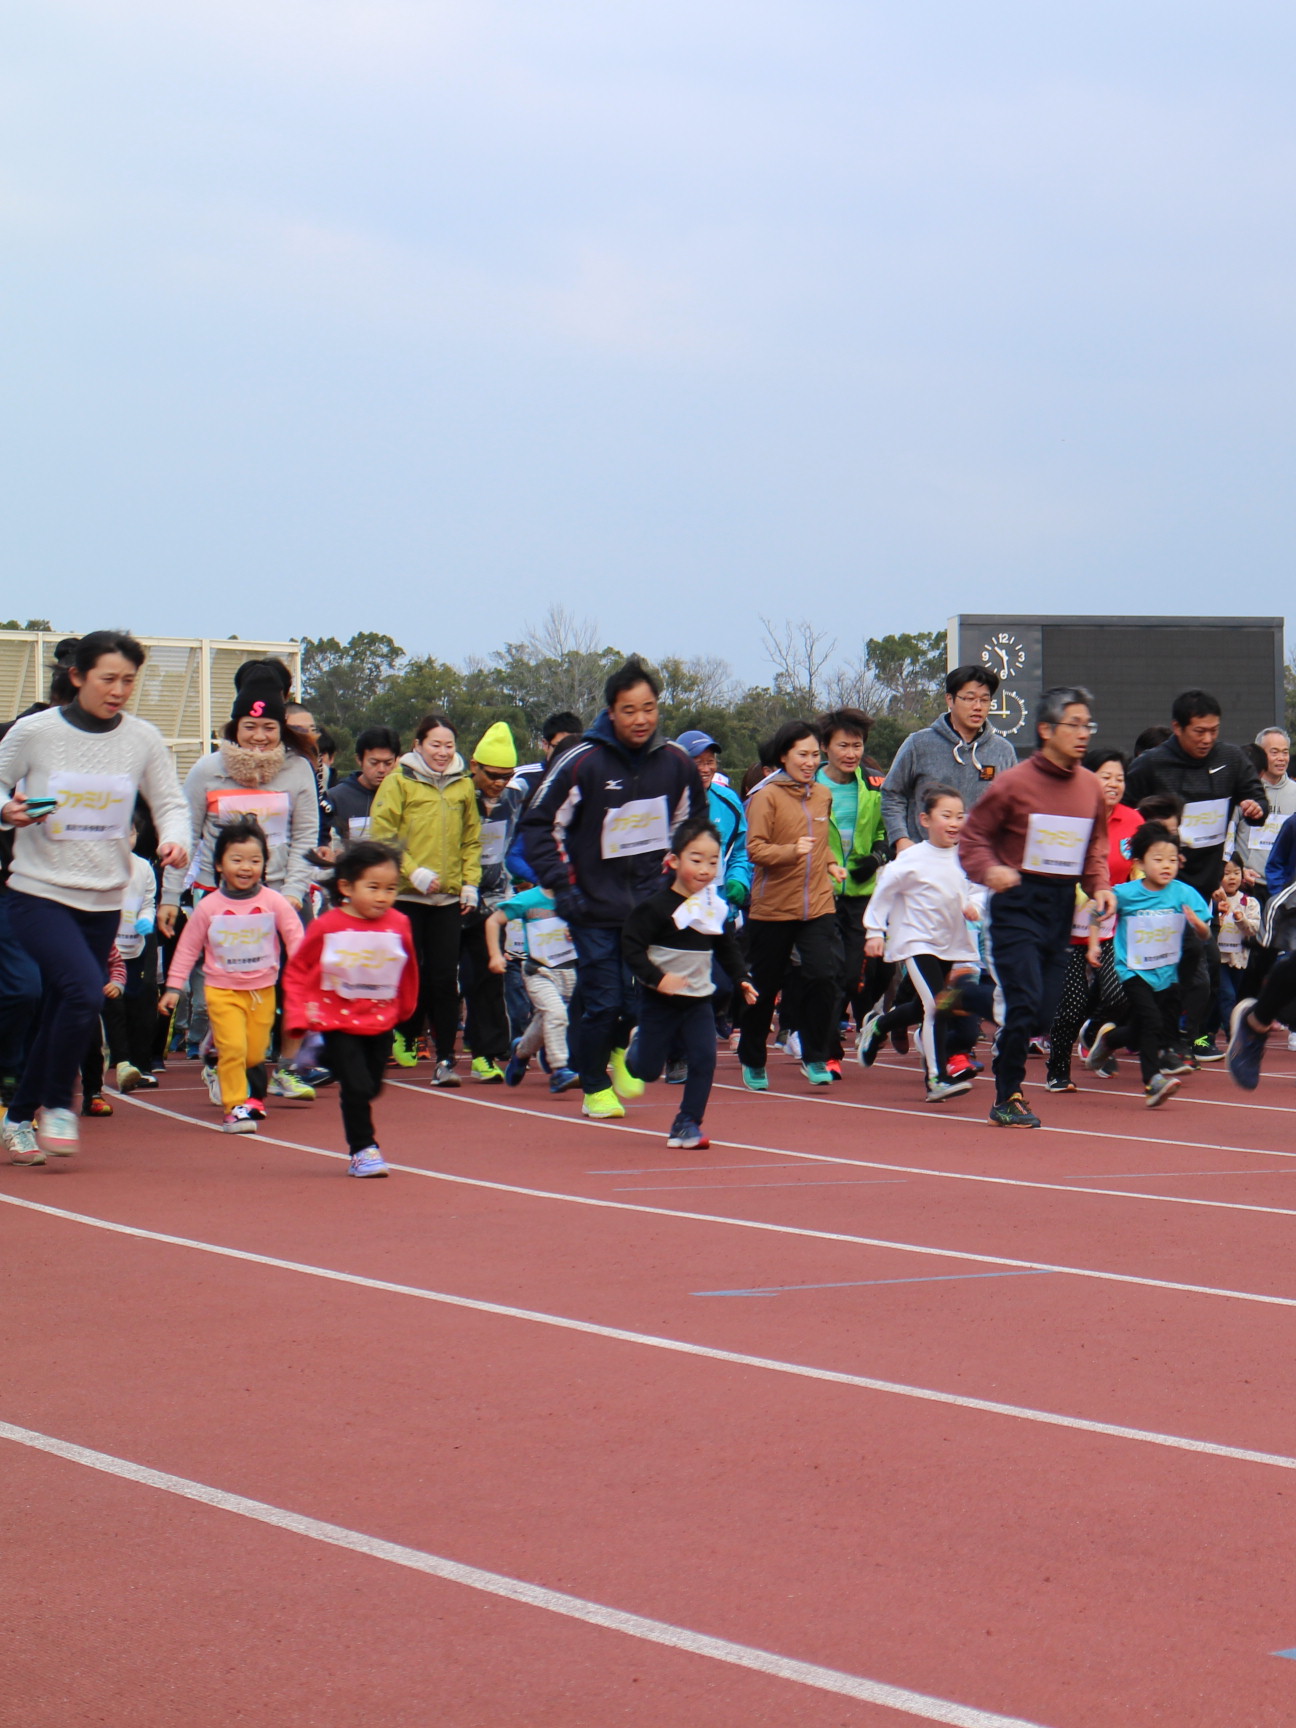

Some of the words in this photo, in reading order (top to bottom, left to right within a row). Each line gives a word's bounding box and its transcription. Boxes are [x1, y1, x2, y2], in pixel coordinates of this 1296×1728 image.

[998, 633, 1009, 643] 12
[981, 651, 990, 661] 9
[1018, 651, 1025, 662] 3
[1000, 669, 1007, 679] 6
[250, 701, 265, 717] S
[57, 790, 123, 810] ファミリー
